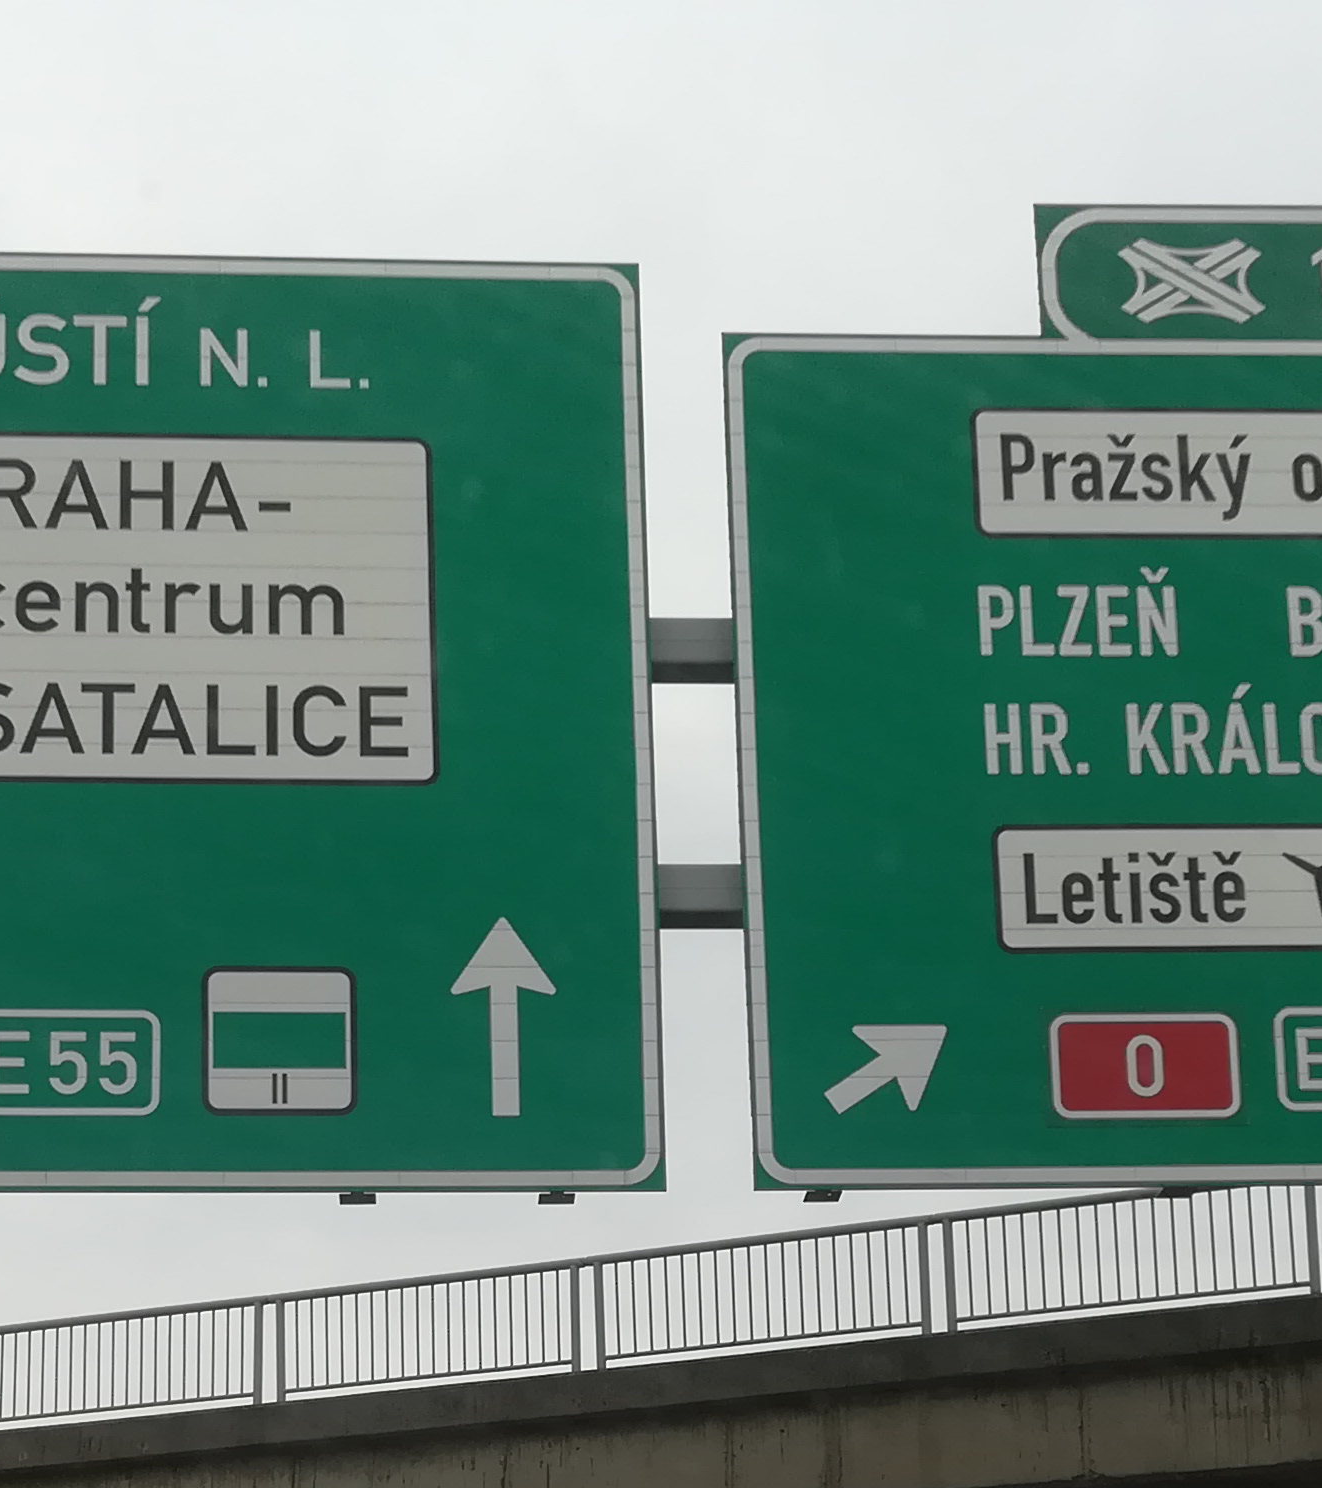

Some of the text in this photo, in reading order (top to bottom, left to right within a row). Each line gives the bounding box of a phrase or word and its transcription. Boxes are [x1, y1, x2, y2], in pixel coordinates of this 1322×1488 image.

[199, 327, 268, 388] N.
[309, 329, 370, 389] L.
[999, 433, 1251, 521] Pražský
[977, 566, 1179, 657] PLZEŇ
[983, 702, 1090, 775] HR.
[1022, 850, 1246, 925] Letiště
[1126, 1034, 1164, 1097] 0
